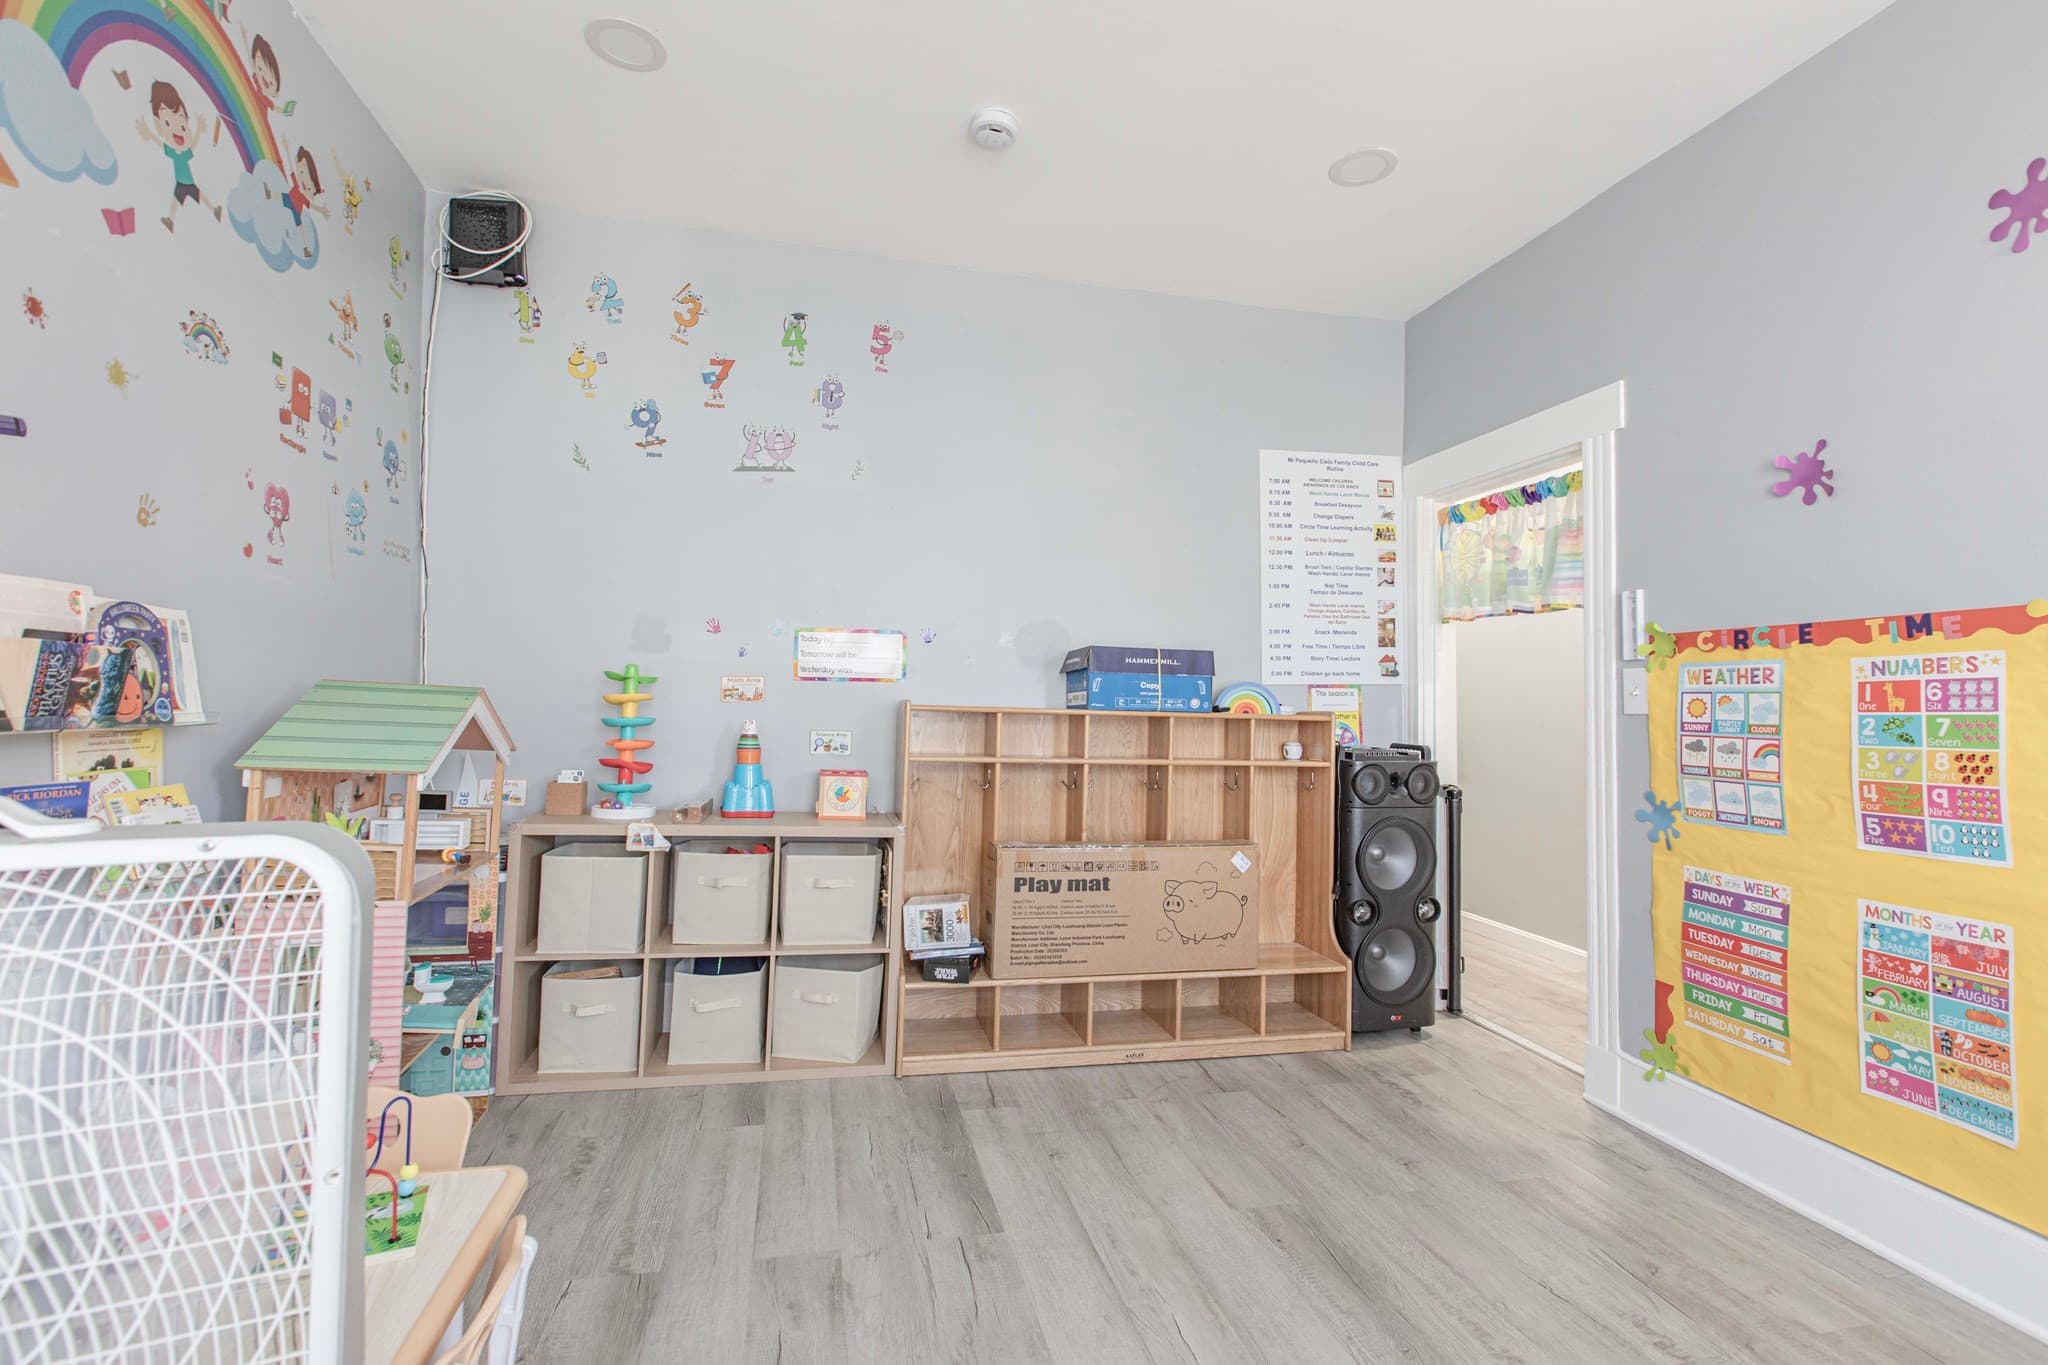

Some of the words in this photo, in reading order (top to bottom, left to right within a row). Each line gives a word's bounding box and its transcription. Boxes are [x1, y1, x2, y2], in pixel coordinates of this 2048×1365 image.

[1865, 613, 1963, 643] TIME
[800, 634, 822, 645] Today
[800, 650, 834, 658] Tomorrow
[836, 650, 846, 658] will
[800, 666, 835, 675] Yesterday
[1687, 666, 1775, 685] WEATHER
[1871, 656, 1979, 677] NUMBERS
[1140, 682, 1160, 690] Copy
[1865, 684, 1870, 702] 1
[1927, 682, 1943, 701] 6
[1859, 702, 1877, 711] One
[1927, 701, 1943, 711] Six
[1683, 723, 1709, 731] SUNNY
[1862, 718, 1876, 736] 2
[1935, 718, 1950, 737] 7
[1860, 736, 1879, 745] Two
[1928, 738, 1961, 747] Seven
[1866, 752, 1880, 769] 3
[1934, 752, 1949, 771] 8
[33, 788, 82, 800] RIORDAN
[1863, 784, 1878, 802] 4
[1932, 788, 1949, 809] 9
[1688, 809, 1711, 819] FOGGY
[1860, 801, 1882, 811] Four
[1929, 807, 1953, 817] Nine
[1753, 818, 1781, 828] SNOWY
[1866, 818, 1881, 835] 5
[1865, 835, 1885, 845] Five
[1932, 824, 1955, 844] 10
[1014, 877, 1062, 894] Play
[1067, 876, 1111, 892] mat
[1694, 870, 1722, 887] DAYS
[1744, 881, 1780, 899] WEEK
[1691, 888, 1734, 908] SUNDAY
[1750, 901, 1773, 916] Sun
[1688, 908, 1736, 929] MONDAY
[1865, 904, 1932, 930] MONTHS
[1956, 921, 2006, 944] YEAR
[1688, 928, 1734, 950] TUESDAY
[1749, 924, 1773, 938] Mon
[1748, 944, 1773, 960] Tues
[1881, 941, 1928, 960] JANUARY
[1685, 948, 1739, 972] WEDNESDAY
[1750, 966, 1771, 982] Wed
[1976, 961, 2008, 978] JULY
[1685, 967, 1740, 994] THURSDAY
[1877, 969, 1928, 990] FEBRUARY
[1692, 989, 1732, 1012] FRIDAY
[1956, 988, 2008, 1009] AUGUST
[1753, 1010, 1769, 1025] Fri
[1889, 1000, 1929, 1020] MARCH
[1687, 1008, 1741, 1036] SATURDAY
[1938, 1014, 2009, 1041] SEPTEMBER
[1752, 1032, 1775, 1049] Sat
[1894, 1030, 1929, 1050] APRIL
[1953, 1048, 2010, 1074] OCTOBER
[1908, 1063, 1932, 1079] MAY
[1943, 1074, 2012, 1104] NOVEMBER
[1902, 1089, 1934, 1109] JUNE
[1948, 1106, 2013, 1138] DECEMBER
